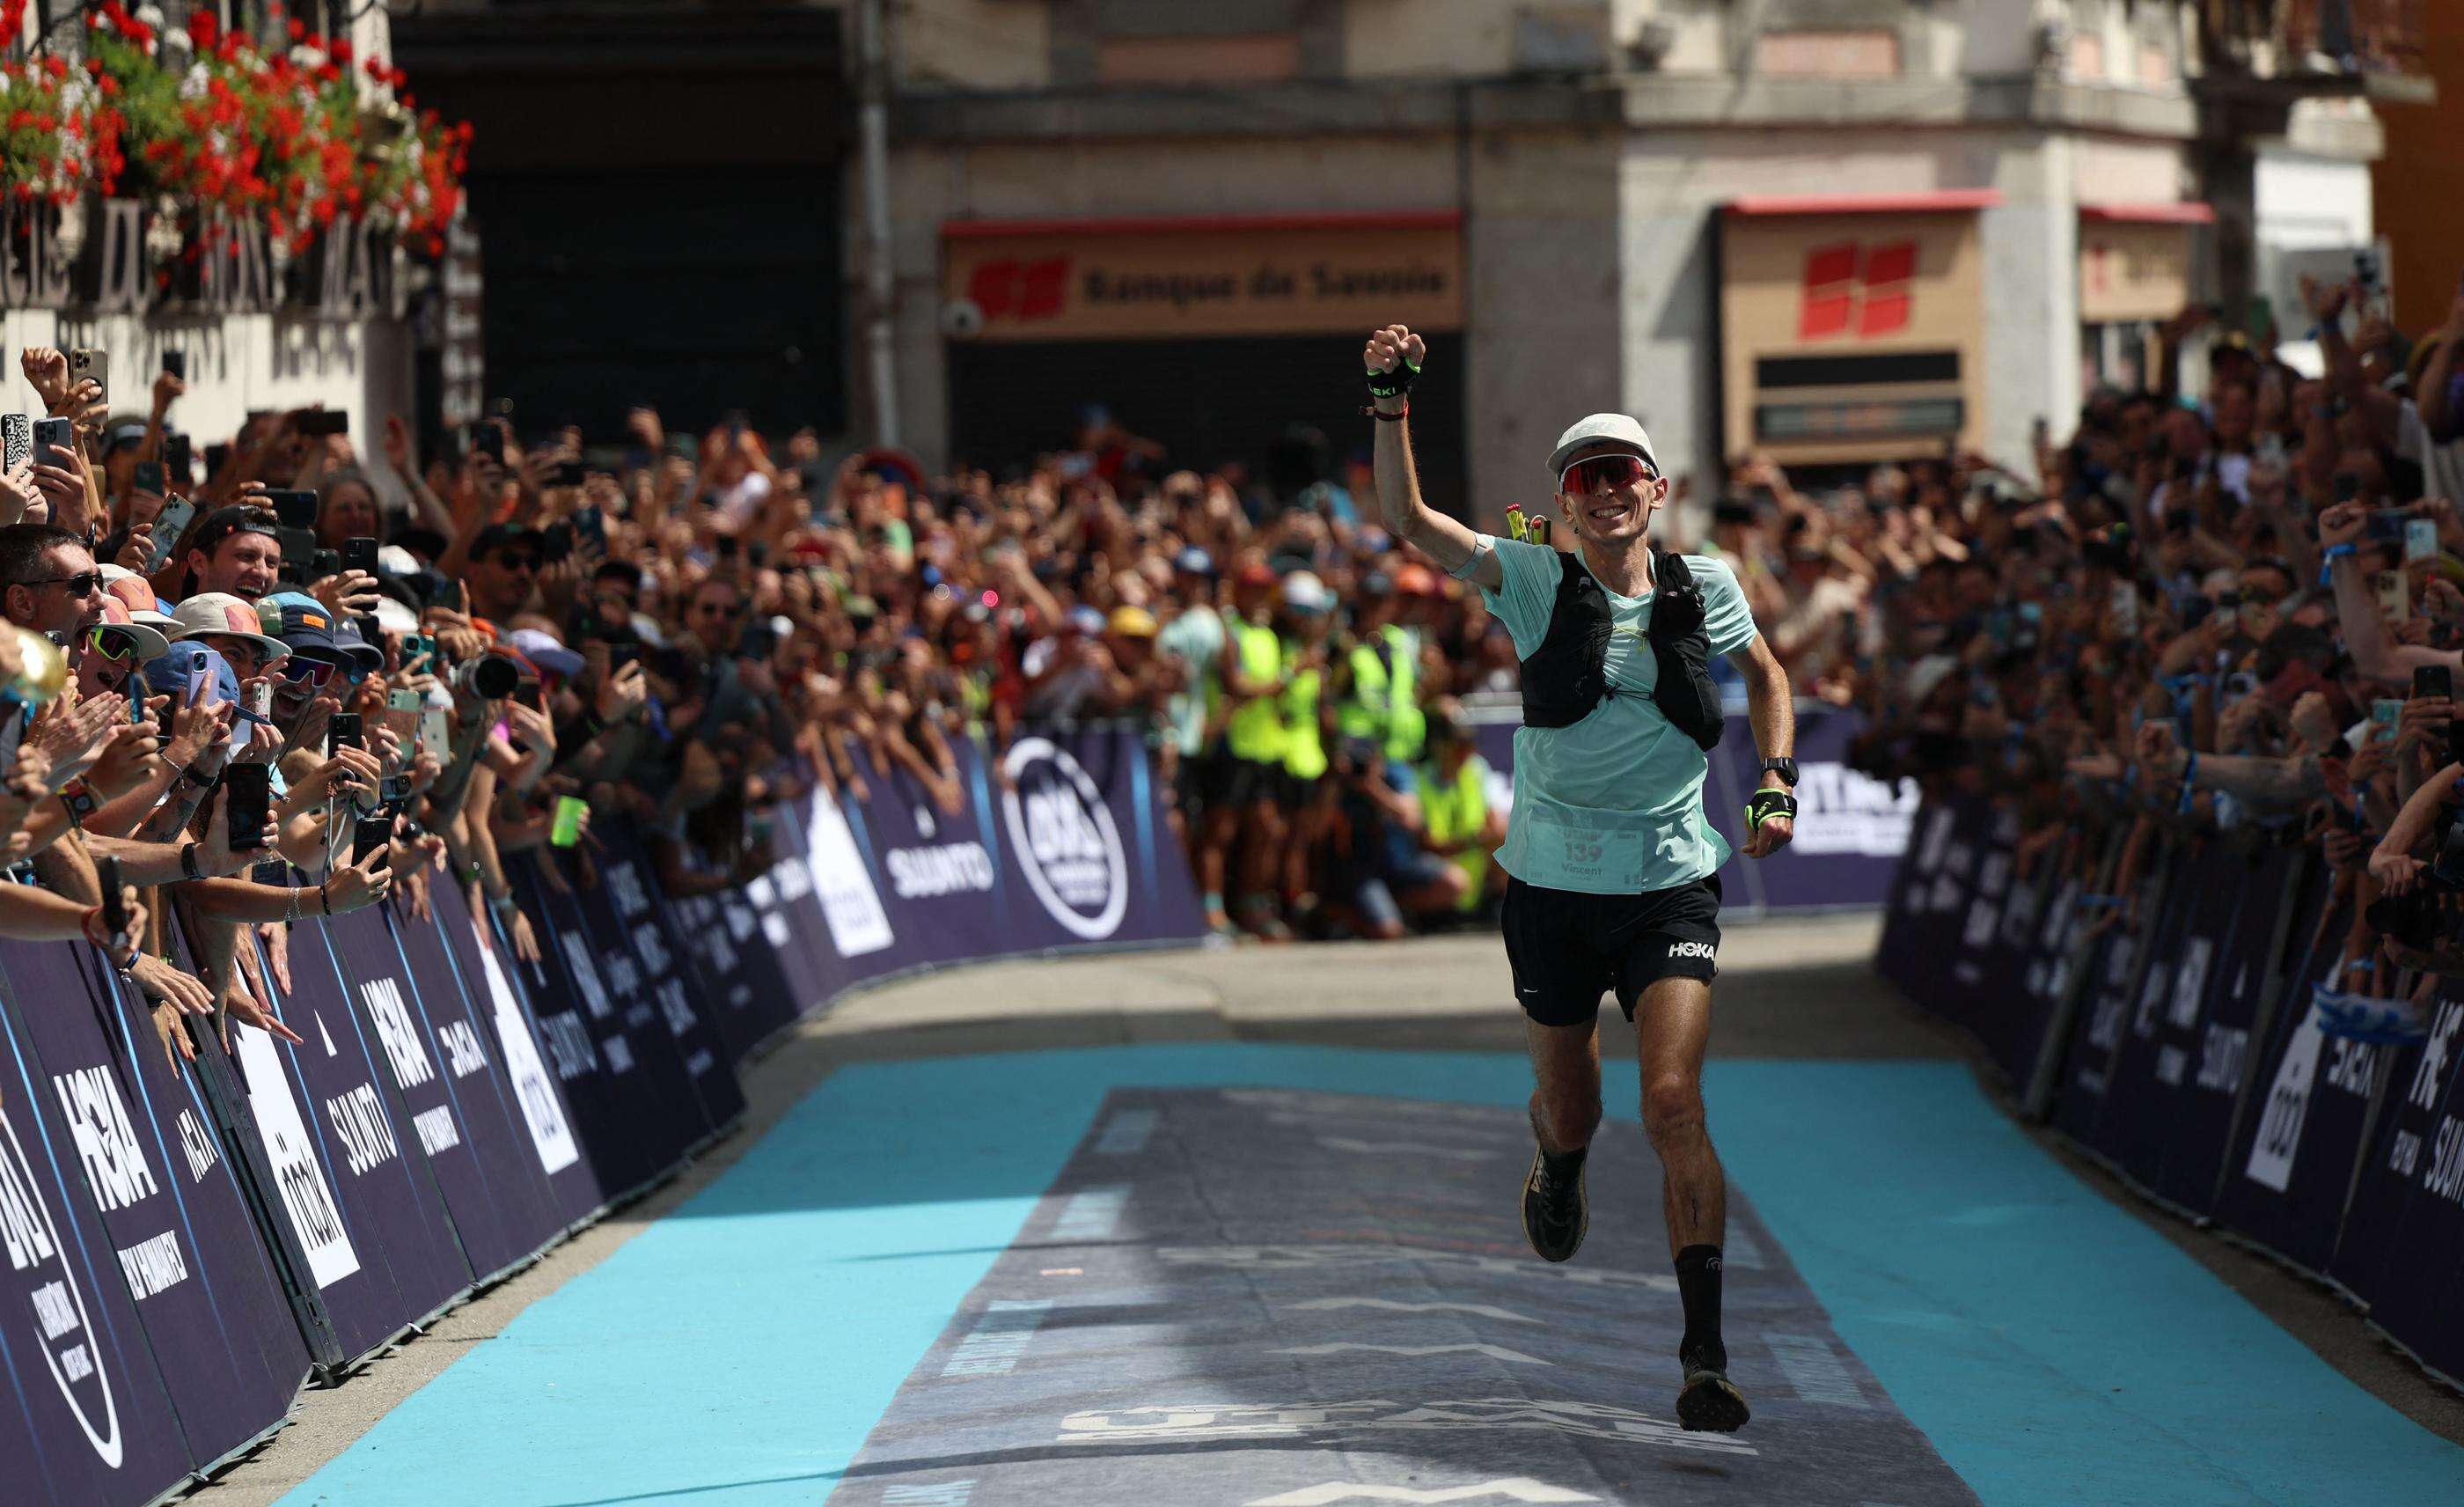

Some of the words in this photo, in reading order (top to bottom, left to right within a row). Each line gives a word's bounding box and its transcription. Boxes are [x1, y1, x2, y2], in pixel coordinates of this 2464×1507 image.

[1084, 267, 1236, 312] Banque
[1250, 264, 1296, 300] de
[1310, 263, 1445, 298] Savoie
[1562, 863, 1602, 876] Vincent
[1565, 842, 1602, 863] 139
[1668, 941, 1715, 961] HOKA
[359, 976, 436, 1091] HOKA
[54, 1064, 159, 1213] HOKA
[326, 1081, 398, 1176] SUUNTO
